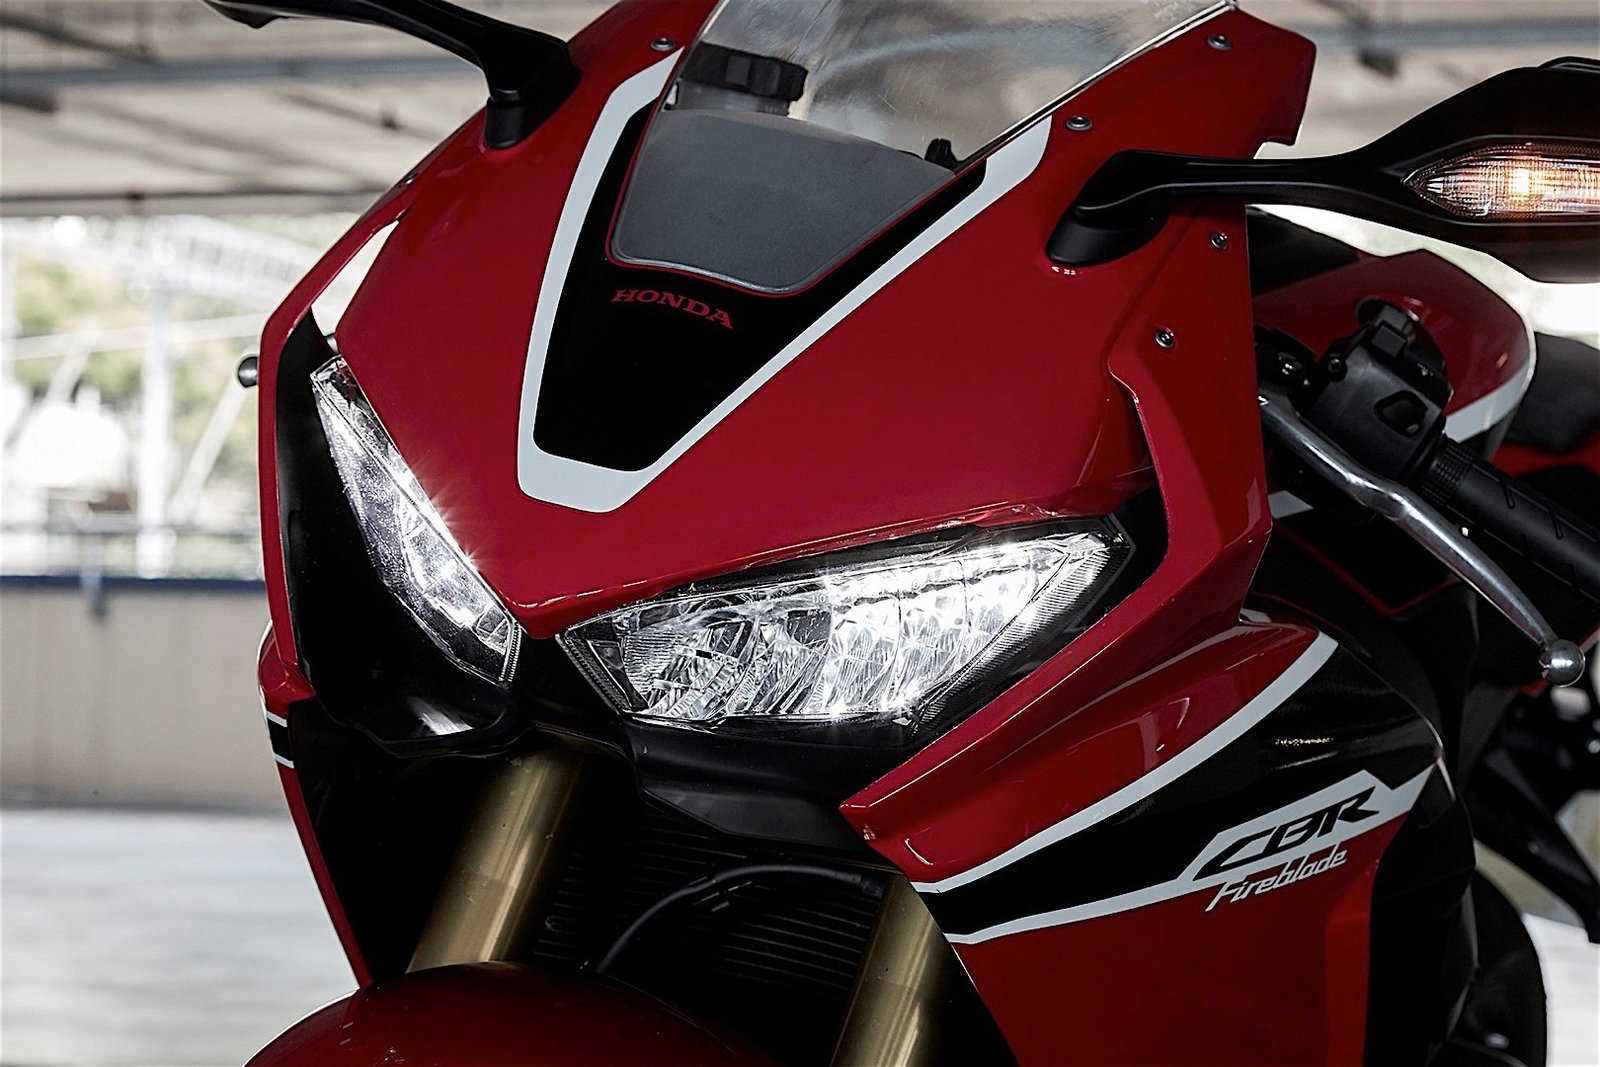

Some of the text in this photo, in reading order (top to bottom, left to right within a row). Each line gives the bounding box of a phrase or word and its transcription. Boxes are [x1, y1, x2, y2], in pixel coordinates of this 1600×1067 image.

[611, 289, 733, 329] HONDA
[1192, 785, 1380, 882] CBR
[1204, 843, 1348, 912] Fireblade
